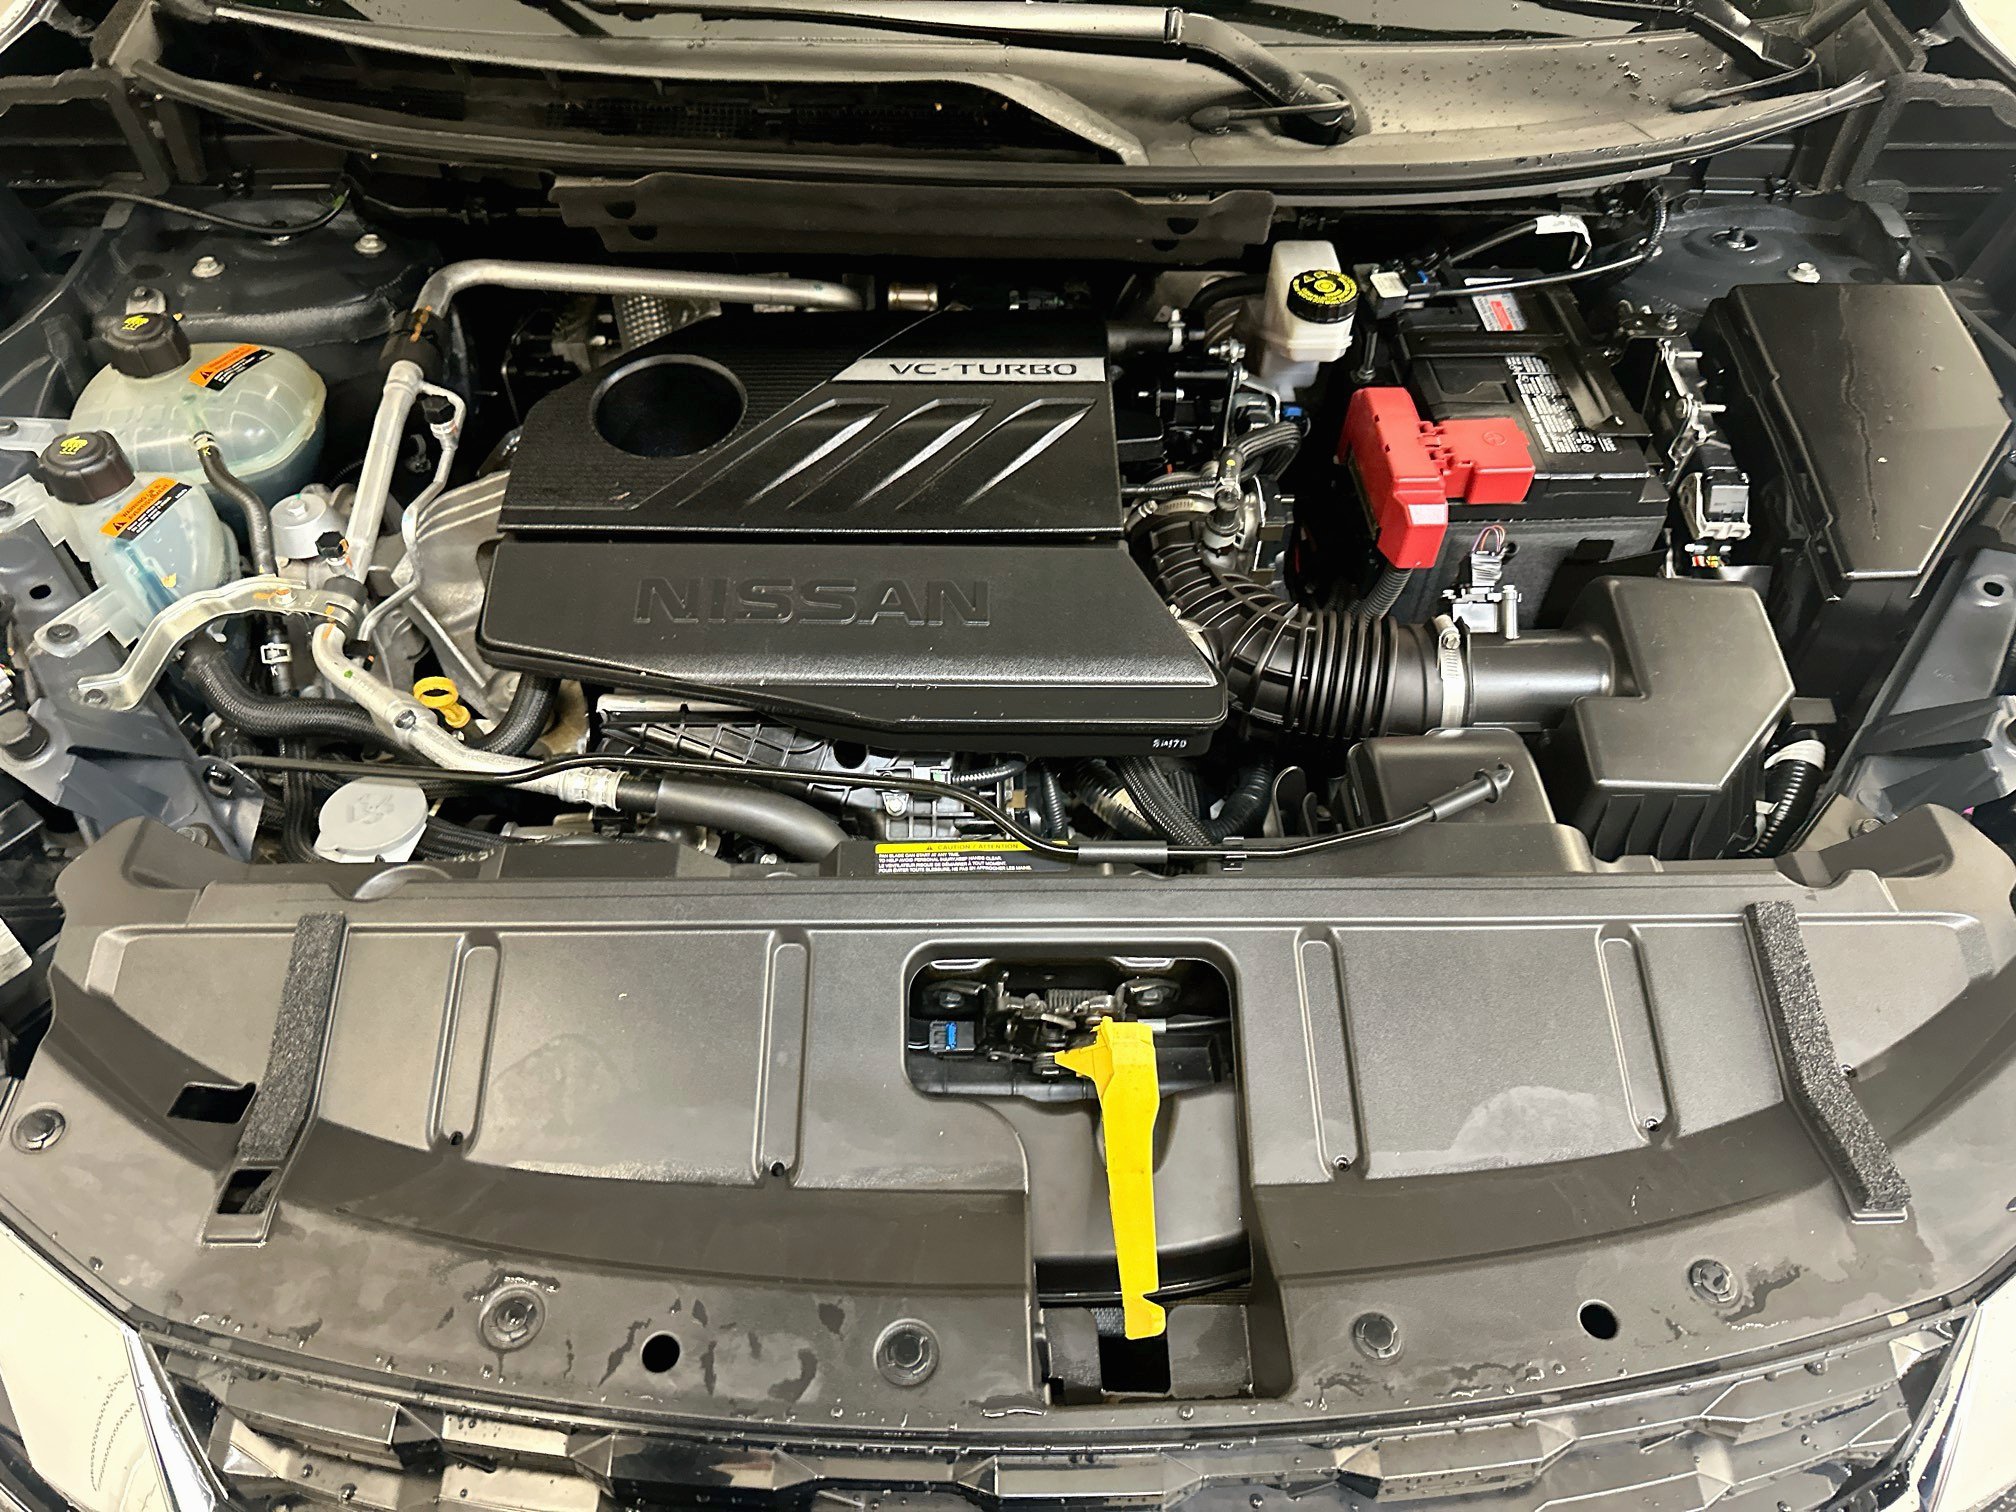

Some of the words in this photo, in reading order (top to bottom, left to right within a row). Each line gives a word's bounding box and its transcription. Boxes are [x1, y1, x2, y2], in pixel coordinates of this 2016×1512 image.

[889, 363, 1078, 376] VC-TURBO
[633, 577, 990, 626] NISSAN
[270, 665, 278, 676] K
[978, 842, 1018, 850] ATTENTION
